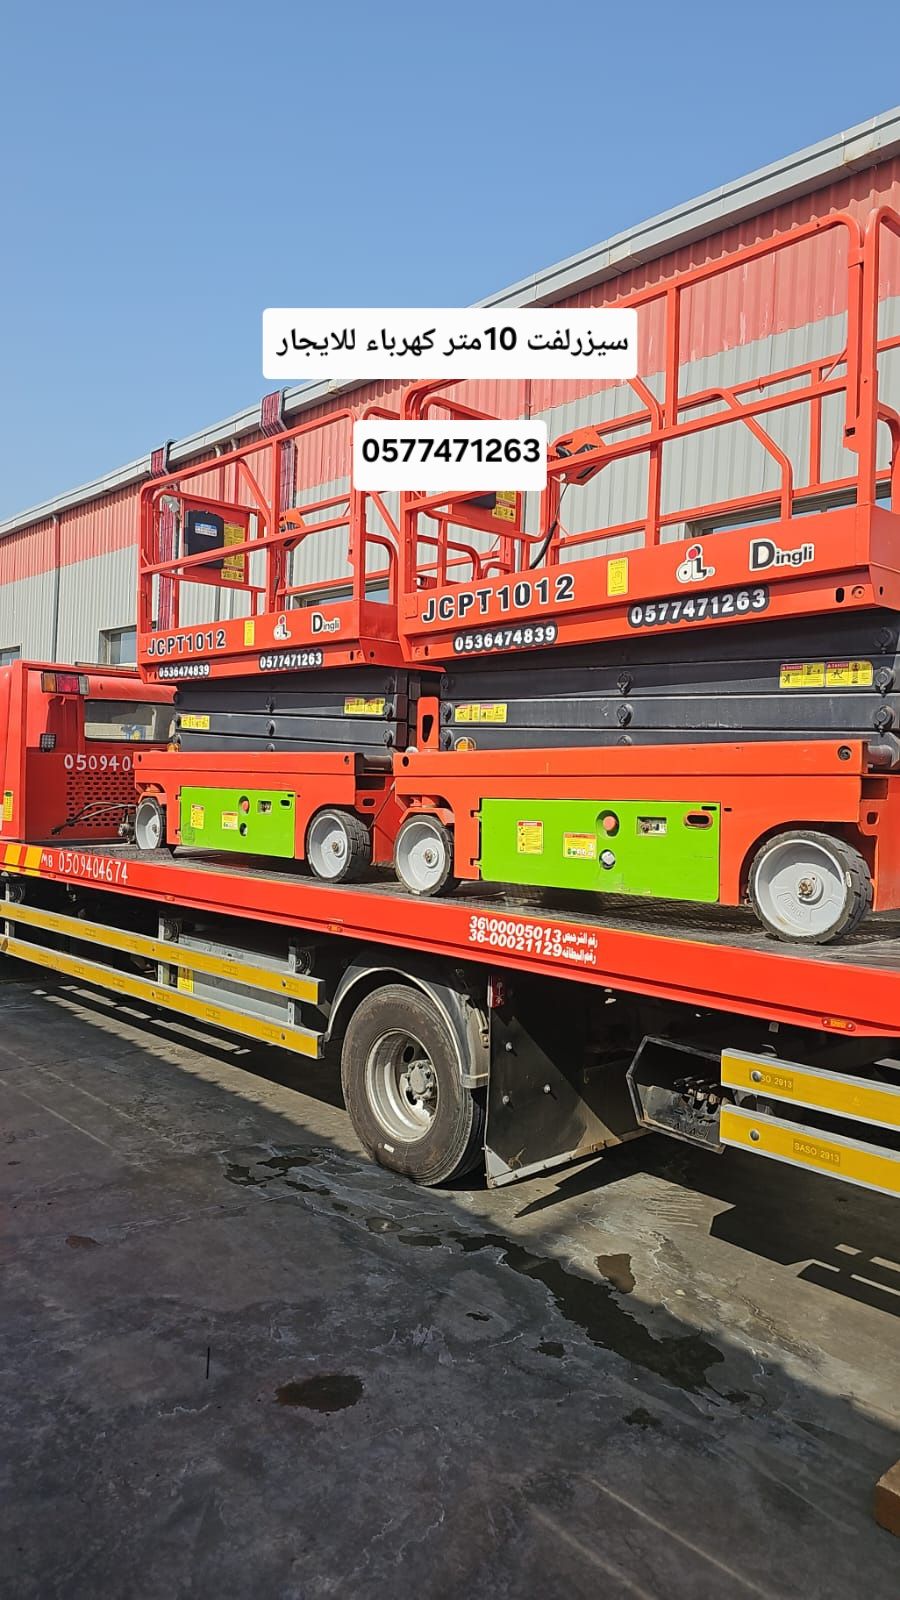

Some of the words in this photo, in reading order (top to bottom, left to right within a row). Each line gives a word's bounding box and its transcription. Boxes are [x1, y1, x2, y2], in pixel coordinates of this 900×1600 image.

[750, 539, 814, 570] Dingli
[421, 574, 575, 623] JCPT1012
[631, 588, 766, 624] 0577471263
[312, 613, 340, 634] Dingli
[148, 631, 226, 655] JCPT1012
[454, 625, 556, 651] 0536474839
[158, 665, 209, 677] 0536474839
[260, 652, 322, 669] 0577471263
[64, 753, 133, 771] 050940
[58, 851, 128, 884] 0509404674
[469, 929, 562, 957] 36-00021129
